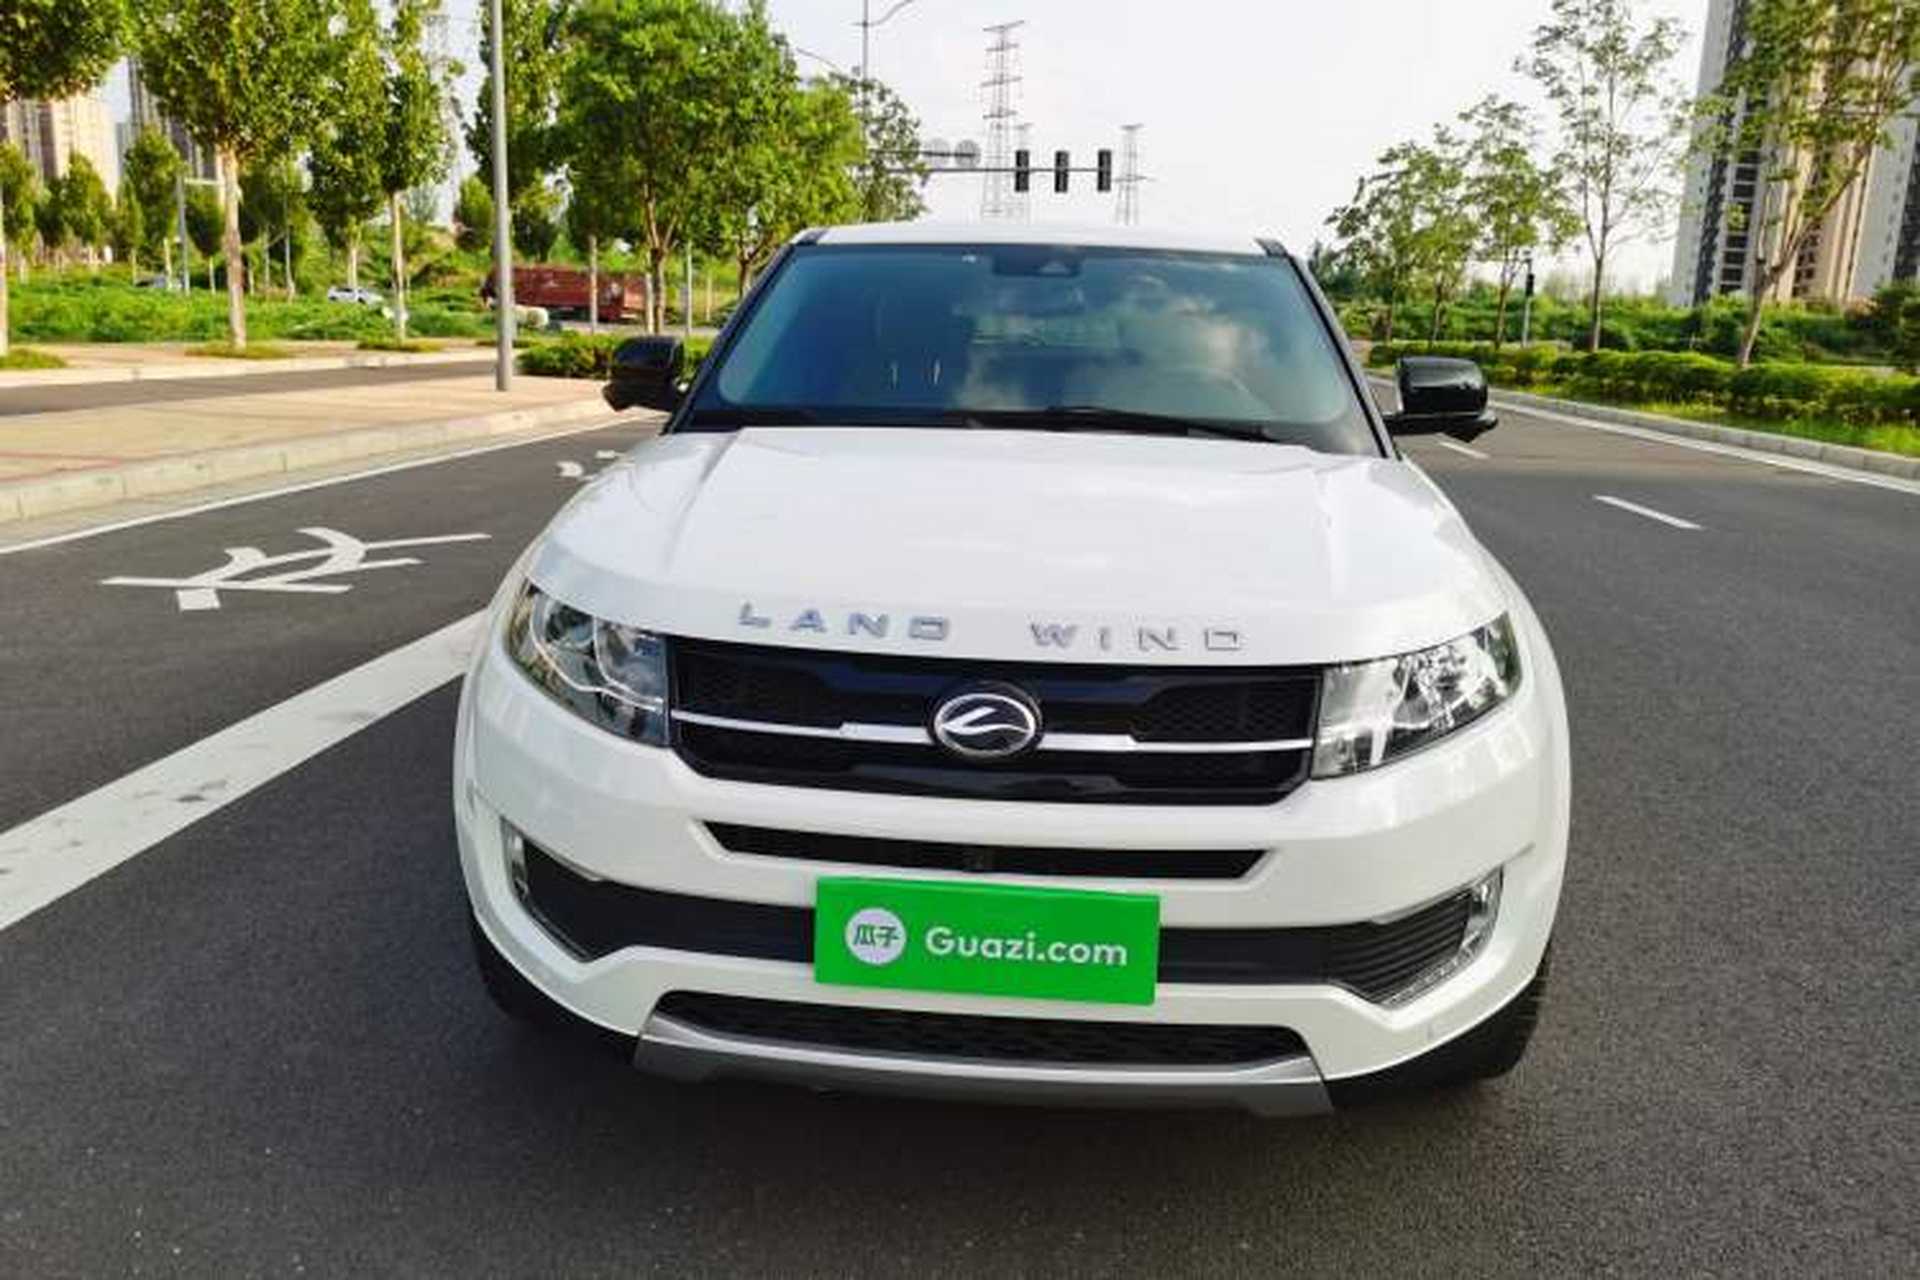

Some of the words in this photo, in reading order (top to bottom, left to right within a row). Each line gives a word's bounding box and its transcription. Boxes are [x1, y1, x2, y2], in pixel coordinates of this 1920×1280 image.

[738, 602, 950, 641] LAND
[1030, 619, 1243, 652] WIND
[853, 923, 899, 949] 瓜子
[925, 926, 1128, 966] Guazi.com
